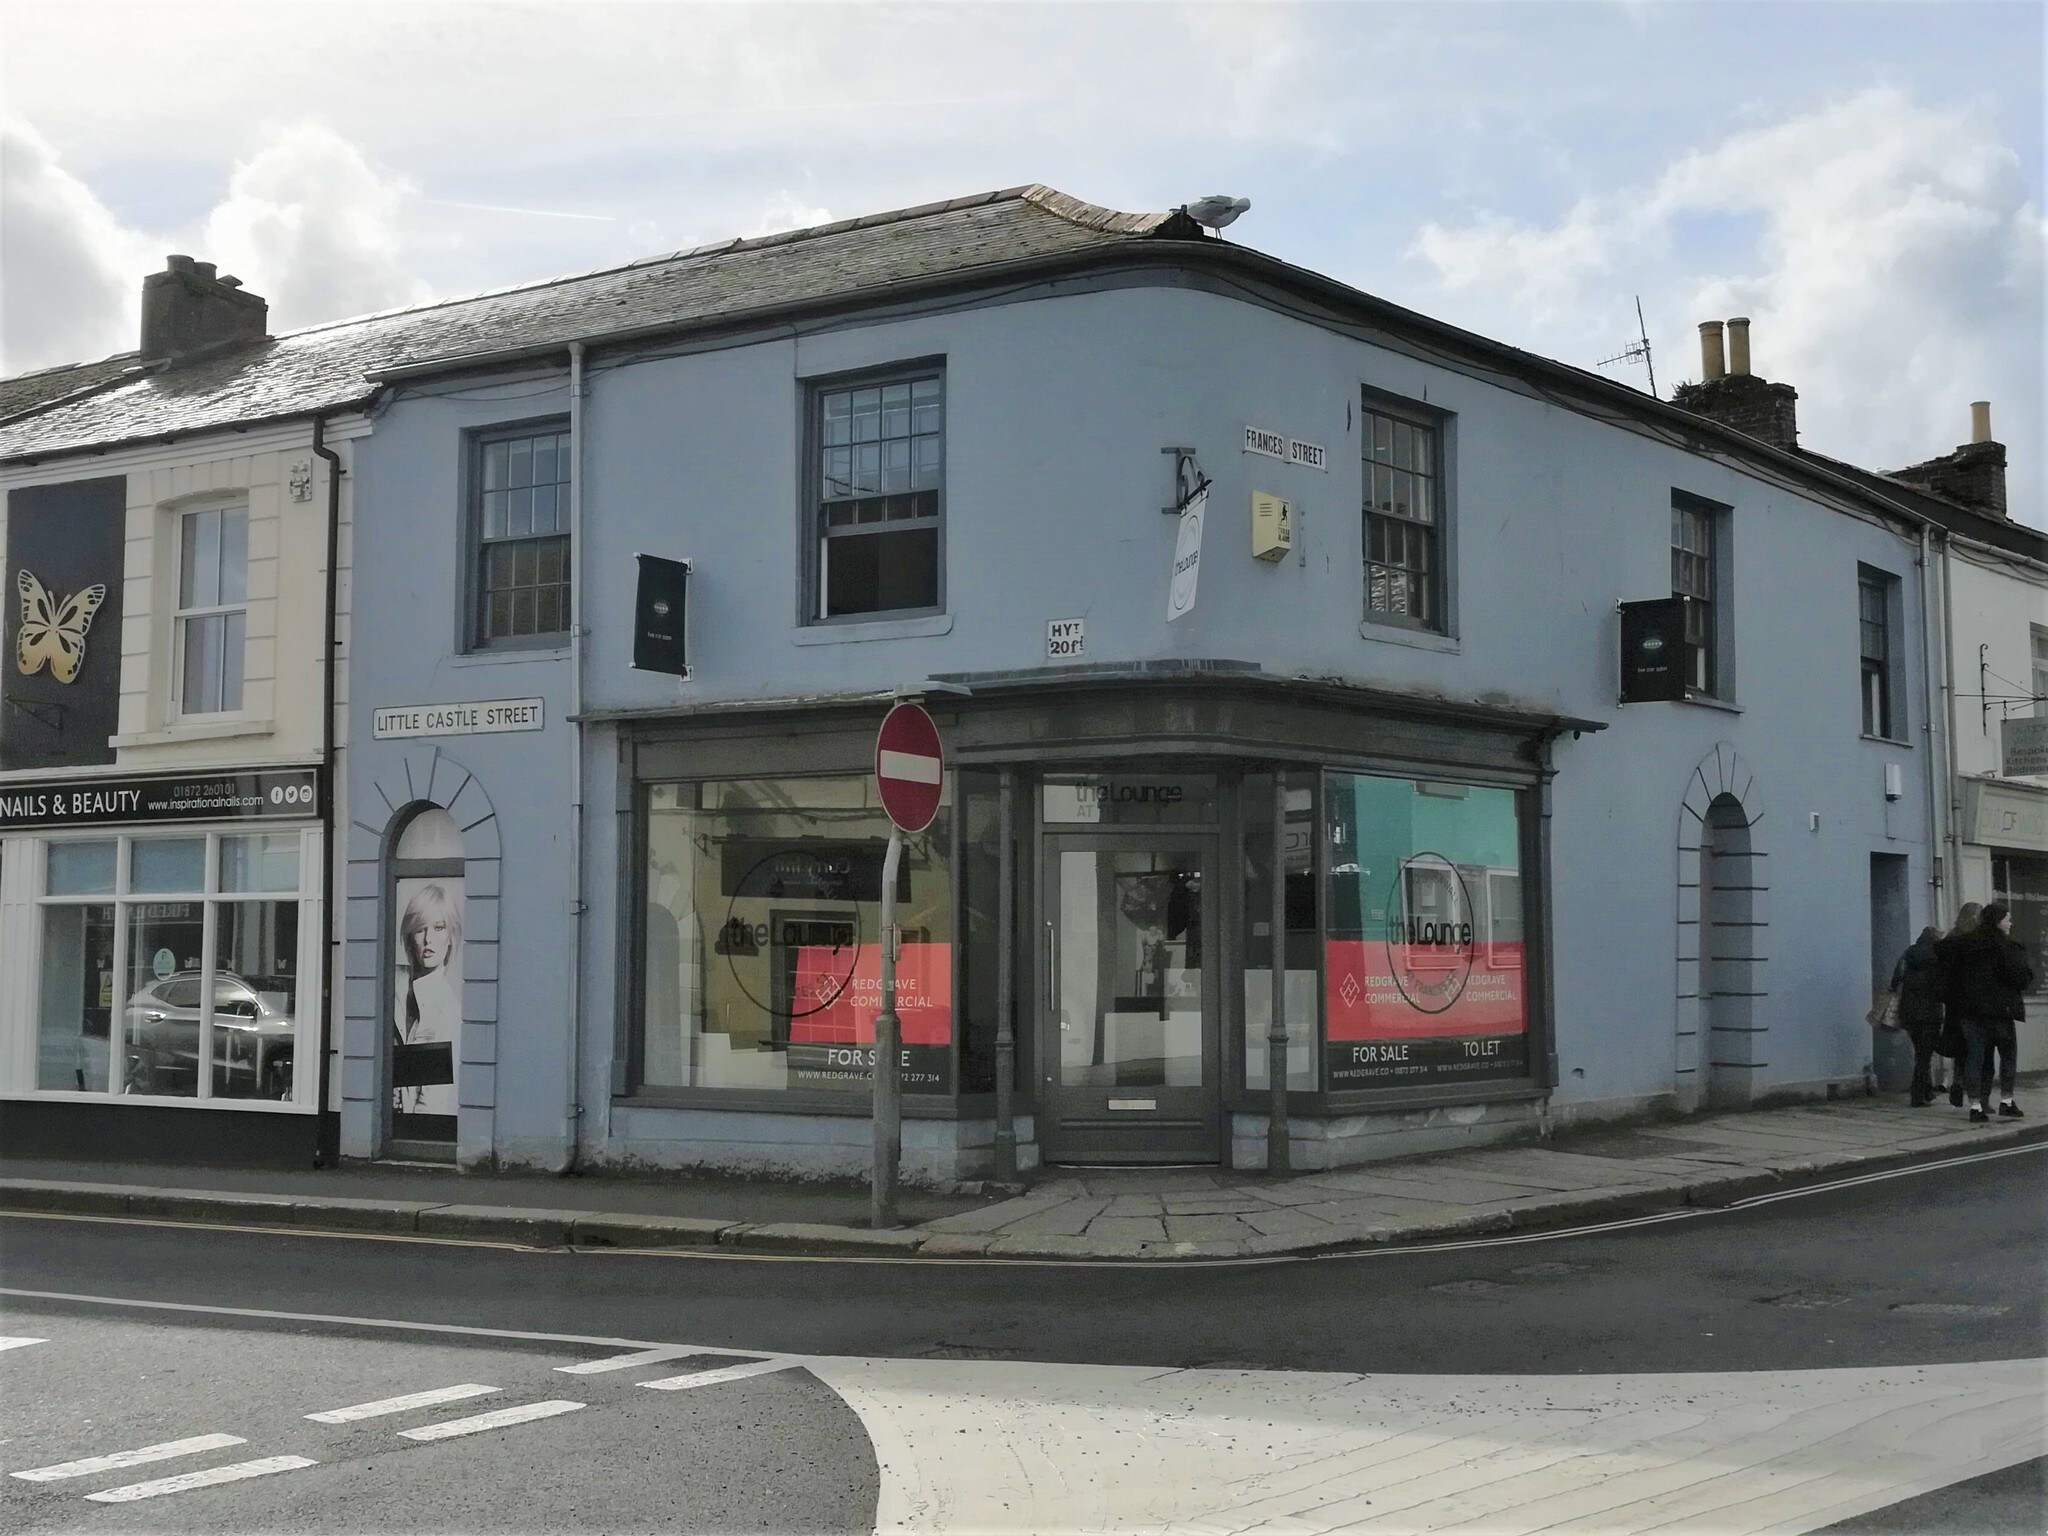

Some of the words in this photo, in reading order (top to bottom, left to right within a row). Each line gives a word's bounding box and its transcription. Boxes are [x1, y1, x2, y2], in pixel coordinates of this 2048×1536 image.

[1246, 429, 1283, 456] FRANCES
[1292, 442, 1324, 466] STREET
[378, 713, 420, 732] LITTLE
[426, 710, 478, 729] CASTLE
[486, 706, 538, 725] STREET
[173, 786, 201, 798] 01872
[203, 783, 236, 796] 260101
[1076, 781, 1183, 805] theLounge
[0, 795, 47, 817] NAILS
[52, 794, 67, 815] &
[72, 790, 141, 814] BEAUTY
[148, 796, 264, 812] www.inspirationalnails.com
[1077, 805, 1092, 818] AT
[1389, 915, 1472, 955] theLounge
[851, 979, 916, 990] REDGAVE
[1365, 976, 1409, 987] REDGRAVE
[1467, 974, 1506, 985] REDGRAVE
[850, 996, 934, 1007] COMRCIAL
[1365, 993, 1421, 1004] COMMERCIAL
[1466, 990, 1517, 1001] COMMERCIAL
[1353, 1046, 1378, 1063] FOR
[1381, 1045, 1409, 1061] SALE
[1463, 1042, 1479, 1057] TO
[1481, 1040, 1501, 1056] LET
[828, 1049, 863, 1066] FOR
[867, 1049, 911, 1067] SE
[911, 1074, 925, 1082] 277
[927, 1074, 940, 1083] 314
